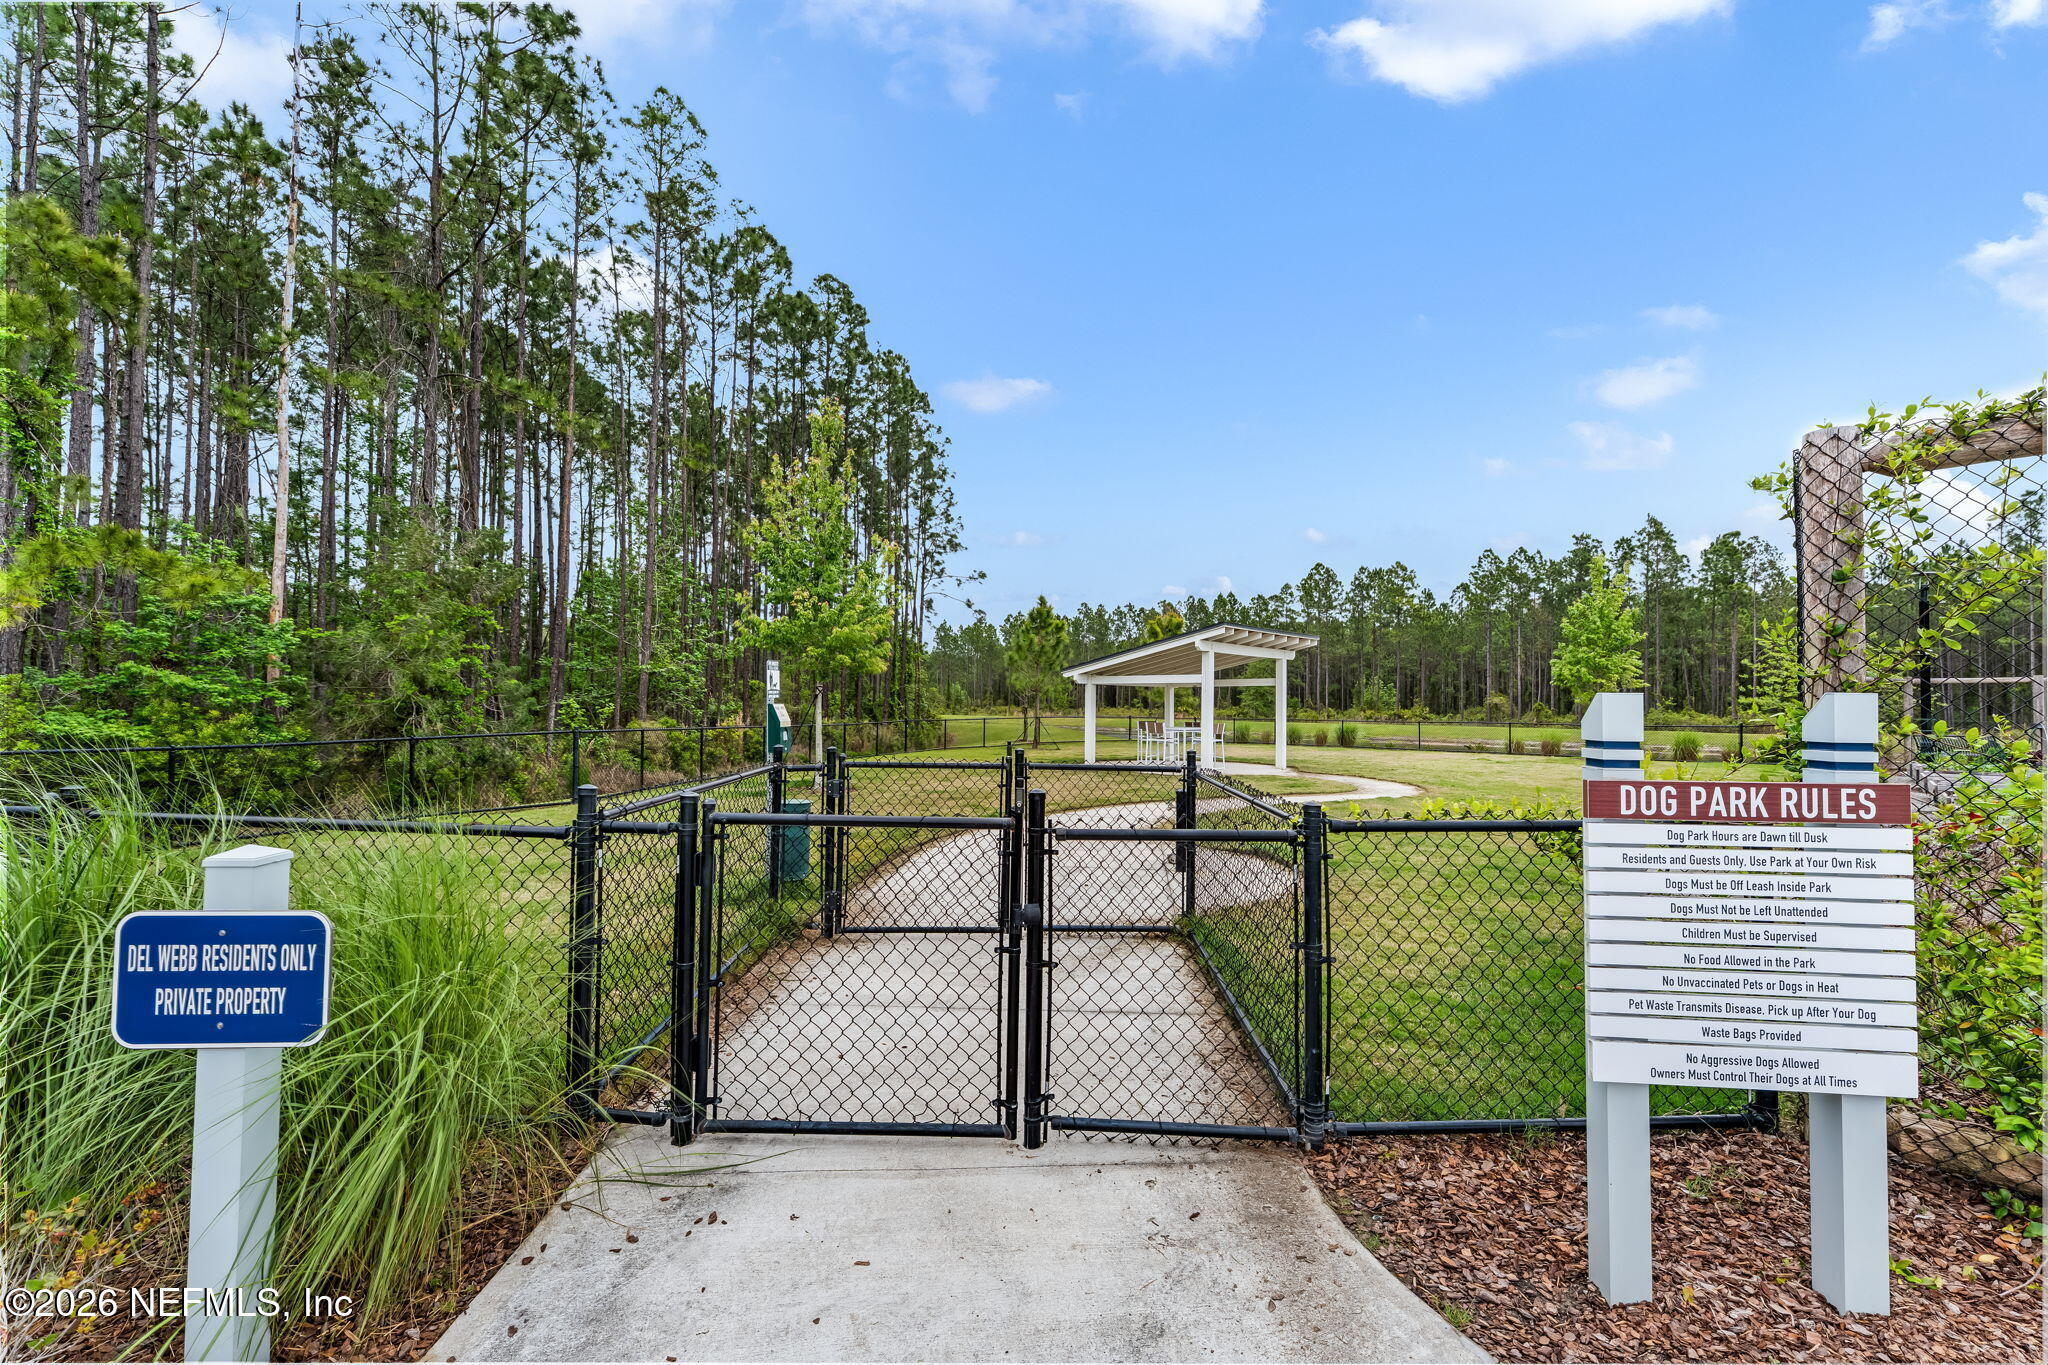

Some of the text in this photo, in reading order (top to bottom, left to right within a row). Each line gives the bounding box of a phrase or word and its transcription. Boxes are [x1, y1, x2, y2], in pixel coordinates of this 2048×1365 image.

[1620, 784, 1876, 819] DOG PARK RULES
[1667, 829, 1828, 843] Dog Park Hours are Dawn till Dusk
[1622, 852, 1667, 864] Residents
[1669, 854, 1686, 865] and
[1689, 854, 1721, 865] Guests
[1749, 855, 1767, 867] Use
[1769, 855, 1792, 867] Park
[1794, 857, 1804, 867] at
[1805, 856, 1828, 868] Your
[1831, 856, 1852, 868] Own
[1855, 857, 1876, 869] Risk
[1665, 877, 1831, 893] Dogs Must be Off Leash Inside Park
[1670, 902, 1828, 918] Dogs Must Not be Left Unattended
[1681, 927, 1817, 944] Children Must be Supervised
[127, 943, 316, 971] DEL WEBB RESIDENTS ONLY
[1683, 953, 1816, 969] No Food Allowed in the Park
[1662, 975, 1839, 994] No Unvaccinated Pets or Dogs in Heat
[154, 987, 286, 1015] PRIVATE PROPERTY
[1628, 998, 1644, 1010] Pet
[1645, 999, 1674, 1011] Waste
[1675, 1000, 1722, 1013] Transmits
[1767, 1004, 1788, 1016] Pick
[1791, 1008, 1803, 1019] up
[1805, 1006, 1830, 1018] After
[1831, 1007, 1855, 1019] Your
[1857, 1007, 1876, 1023] Dog
[1701, 1026, 1801, 1042] Waste Bags Provided
[1686, 1052, 1819, 1070] No Aggressive Dogs Allowed
[1650, 1067, 1857, 1088] Owners Must Control Their Dogs at All Times
